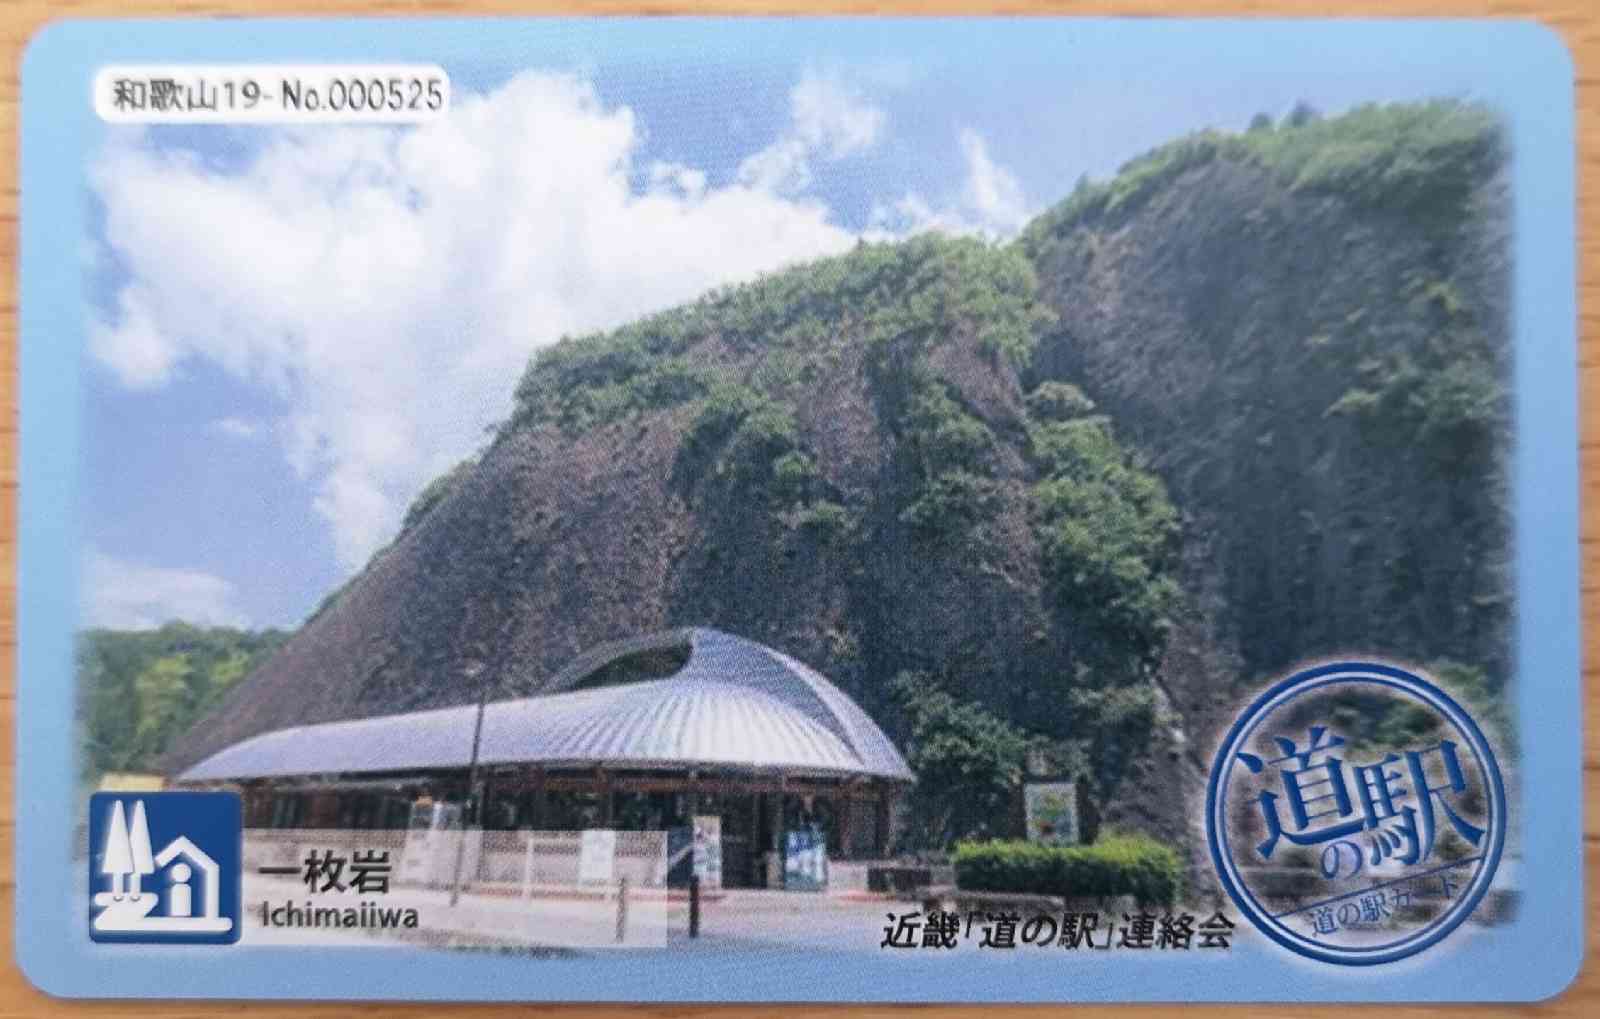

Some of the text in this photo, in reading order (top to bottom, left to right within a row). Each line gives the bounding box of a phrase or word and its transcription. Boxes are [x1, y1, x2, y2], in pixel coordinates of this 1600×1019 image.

[281, 78, 443, 111] No.000525
[258, 849, 392, 894] 一枚岩
[262, 900, 420, 929] Ichimaiiwa
[880, 911, 1236, 951] 近畿「道の駅」連絡会
